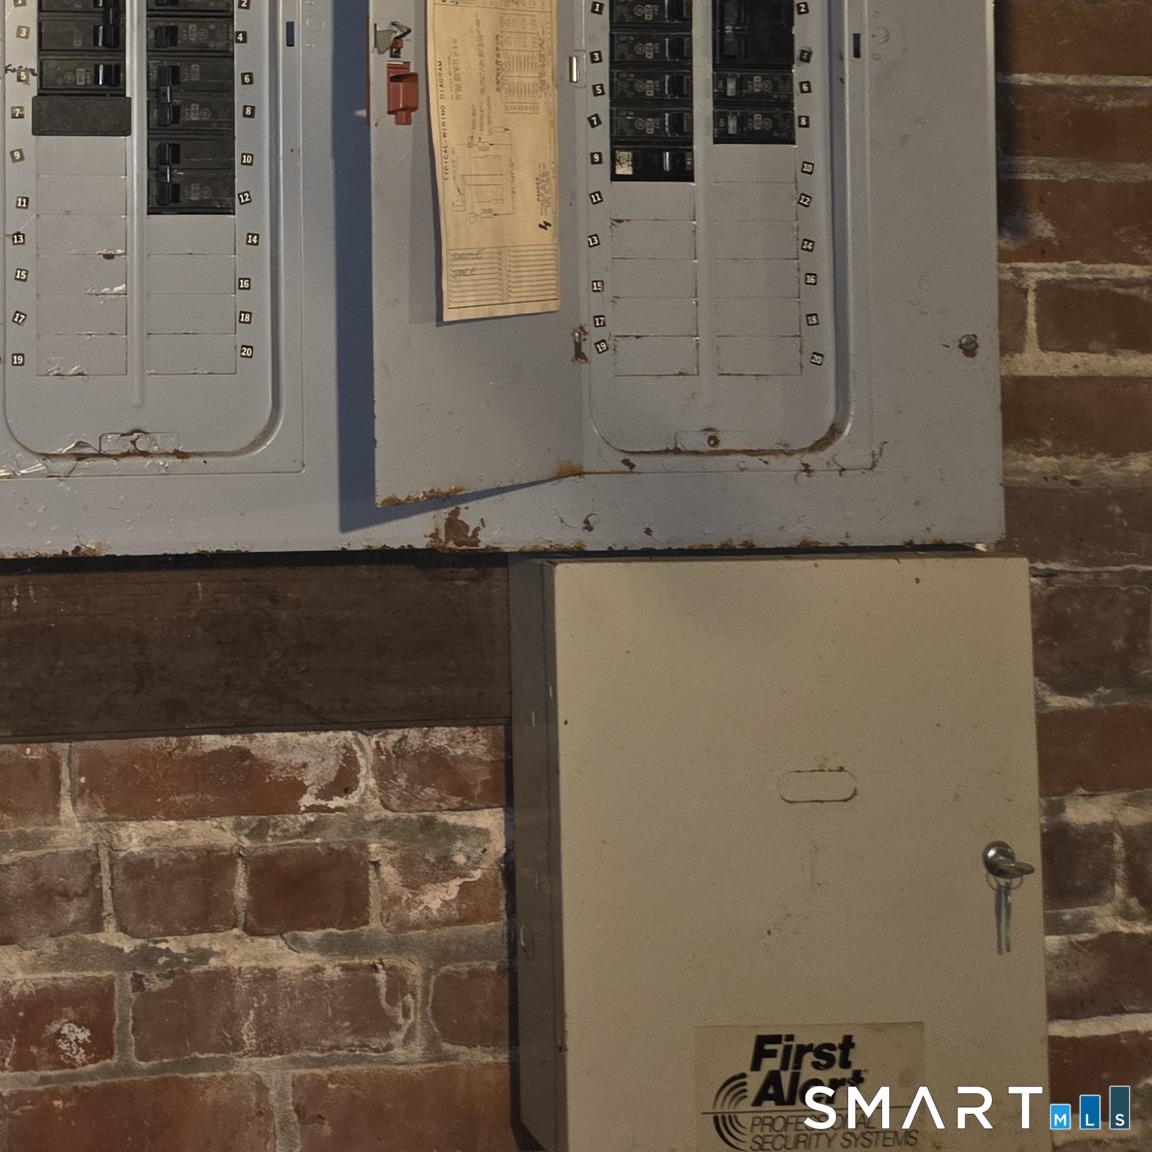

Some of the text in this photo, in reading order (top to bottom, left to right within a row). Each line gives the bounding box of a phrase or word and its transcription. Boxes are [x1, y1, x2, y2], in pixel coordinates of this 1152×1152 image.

[594, 3, 600, 12] 1
[799, 3, 806, 12] 2
[20, 27, 27, 37] 3
[237, 32, 244, 42] 4
[593, 52, 600, 61] 3
[20, 70, 27, 80] 5
[244, 74, 250, 84] 6
[595, 85, 602, 94] 5
[802, 83, 809, 92] 6
[14, 107, 21, 117] 7
[245, 106, 252, 116] 8
[590, 116, 598, 126] 7
[800, 116, 807, 126] 8
[13, 150, 21, 160] 9
[242, 154, 252, 164] 10
[593, 153, 600, 162] 9
[802, 163, 813, 173] 10
[17, 197, 27, 208] 11
[239, 192, 250, 203] 12
[590, 192, 602, 203] 11
[799, 195, 811, 206] 12
[13, 234, 24, 244] 13
[247, 234, 258, 244] 14
[586, 236, 599, 246] 13
[802, 240, 813, 250] 14
[15, 269, 27, 280] 15
[806, 274, 816, 284] 16
[239, 279, 250, 288] 16
[592, 281, 602, 291] 15
[13, 312, 26, 324] 17
[240, 312, 250, 322] 18
[594, 316, 605, 326] 17
[807, 315, 818, 325] 18
[240, 346, 252, 357] 20
[596, 341, 607, 352] 19
[12, 355, 24, 365] 19
[810, 354, 824, 364] 20
[750, 1034, 856, 1071] First
[750, 1130, 918, 1152] SECURITY SYSTEMS
